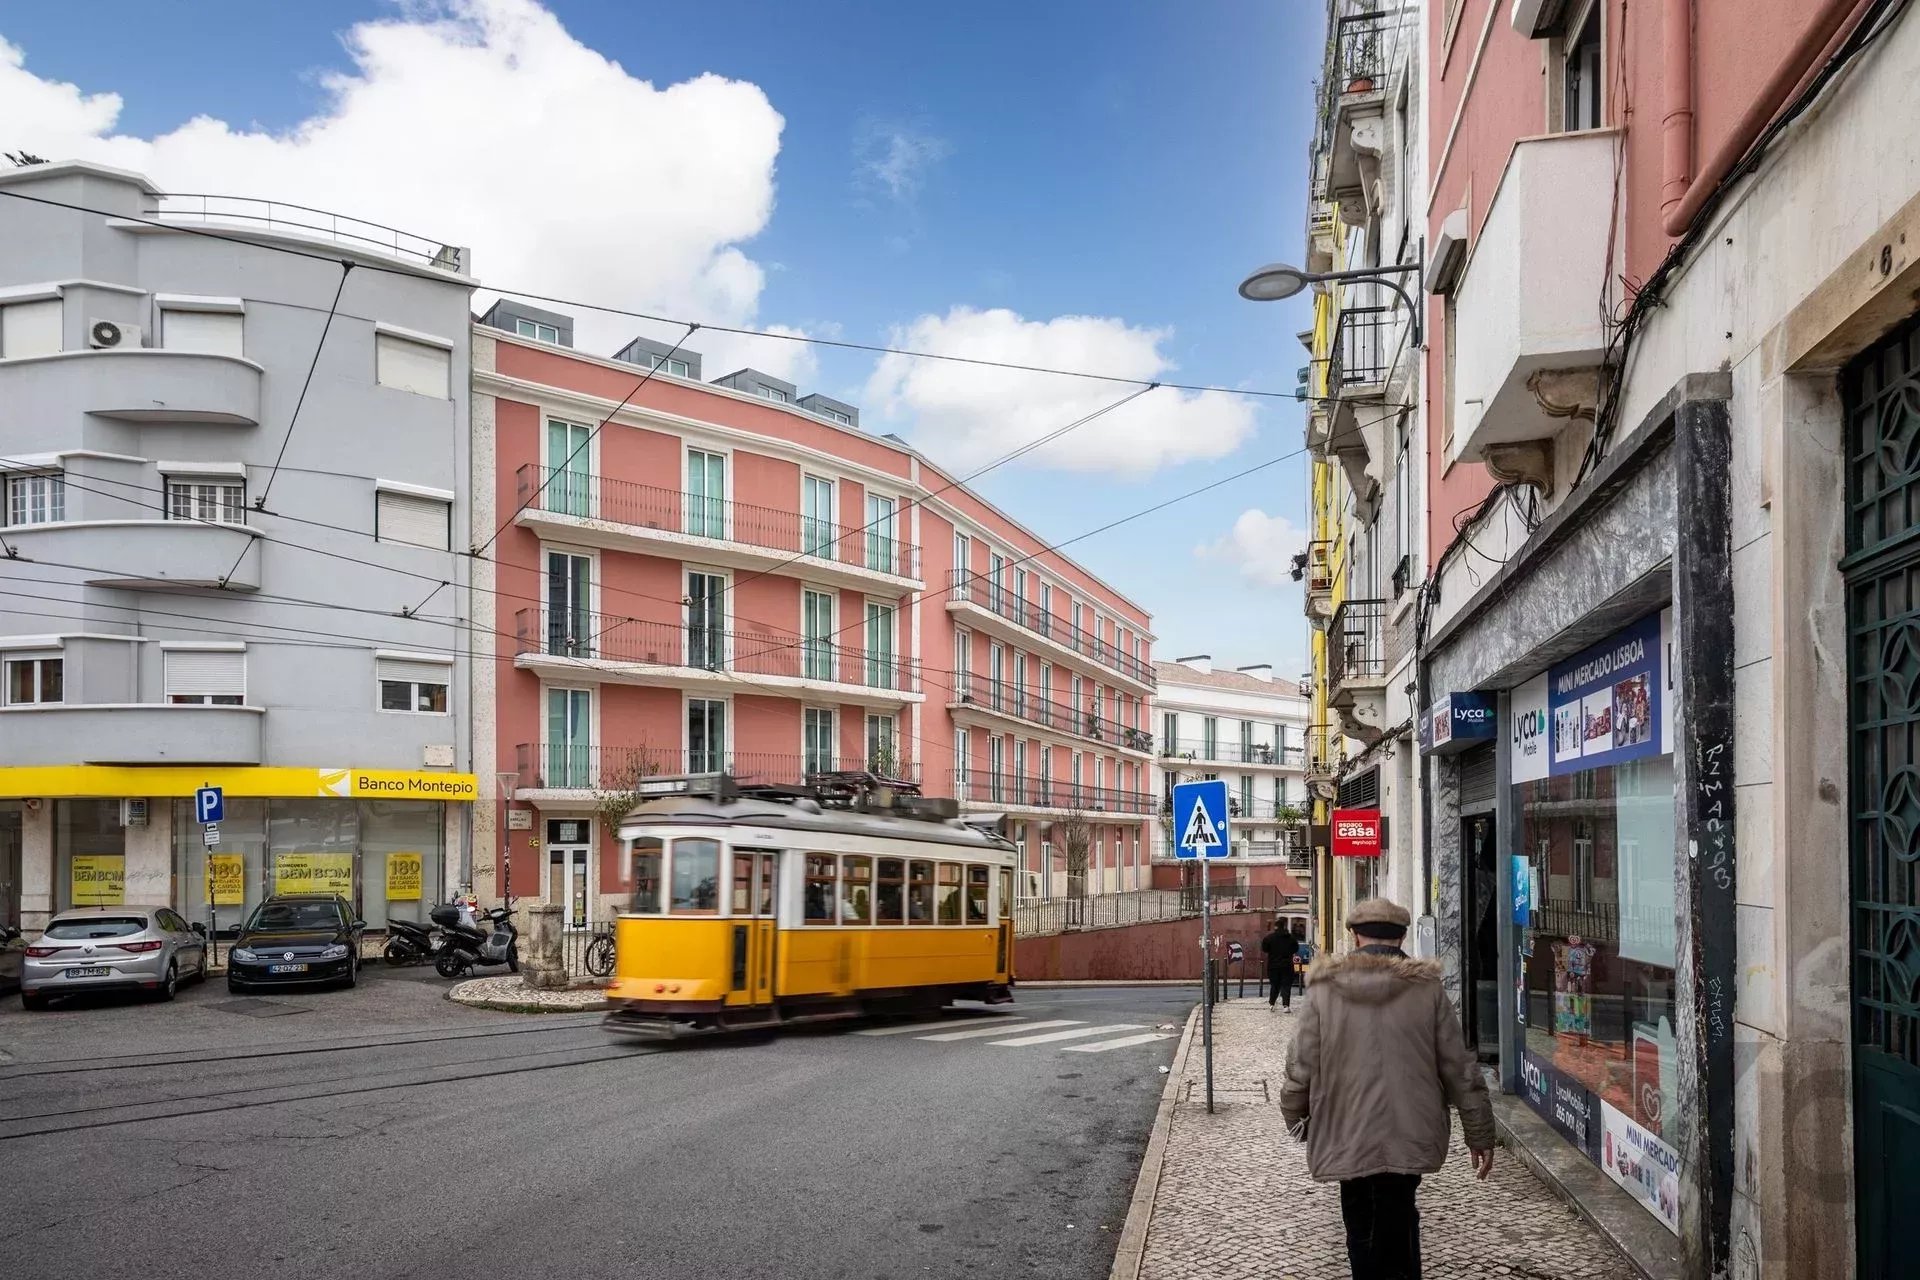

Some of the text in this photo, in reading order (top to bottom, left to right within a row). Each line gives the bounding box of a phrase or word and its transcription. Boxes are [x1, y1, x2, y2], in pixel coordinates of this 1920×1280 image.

[1880, 244, 1892, 276] 6
[1558, 671, 1573, 696] MINI
[1574, 653, 1611, 688] MERCADO
[1613, 638, 1645, 671] LISBOA
[1454, 708, 1484, 721] Lyca
[1513, 710, 1537, 749] Lyca
[1523, 741, 1537, 757] Mobile
[359, 776, 473, 795] Banco Montepio
[202, 790, 218, 820] P
[1338, 827, 1375, 837] casa
[74, 871, 96, 881] BEM
[97, 871, 124, 881] BOM
[279, 867, 351, 879] BEM BOM
[389, 860, 420, 875] 180
[1520, 1051, 1541, 1091] Lyca
[1626, 1124, 1642, 1148] MINI
